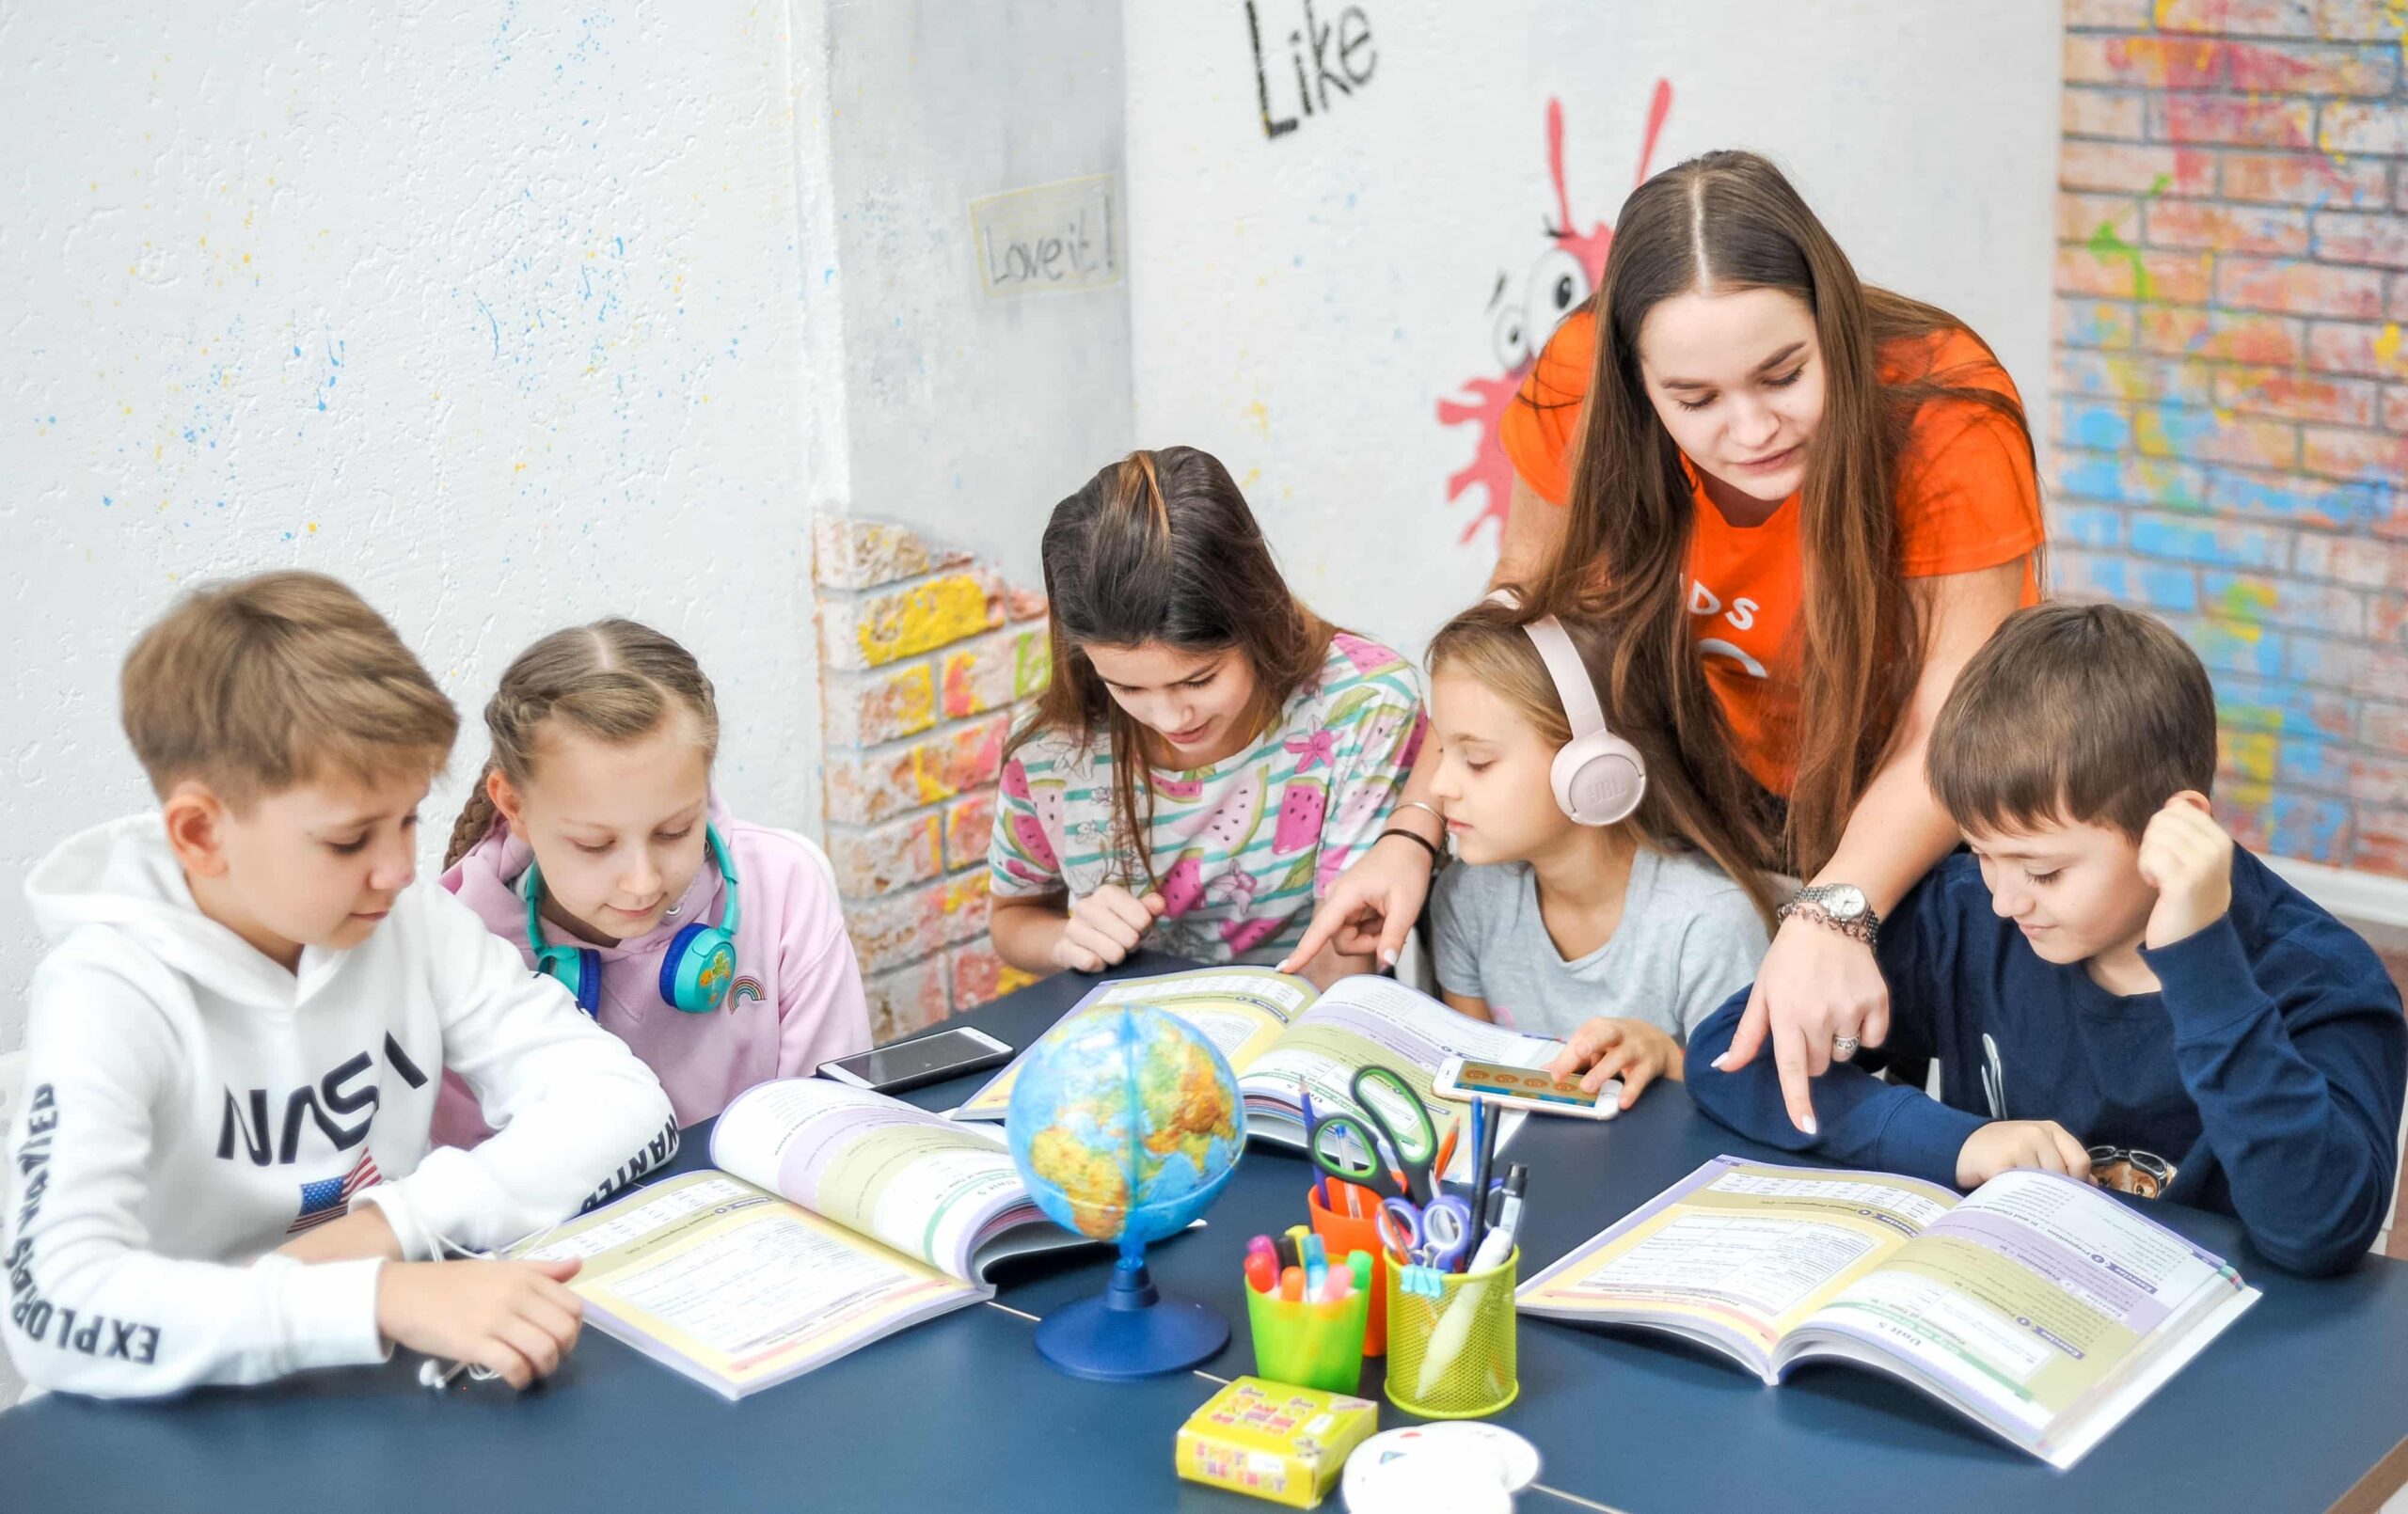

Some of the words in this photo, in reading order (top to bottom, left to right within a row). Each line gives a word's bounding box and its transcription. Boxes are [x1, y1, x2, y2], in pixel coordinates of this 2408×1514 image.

[1246, 0, 1377, 139] Like
[1679, 572, 1761, 631] DS
[2047, 1228, 2090, 1255] Preposition
[2016, 1253, 2060, 1280] Preposition
[2112, 1267, 2151, 1291] Exercise
[2084, 1293, 2122, 1317] Exercise
[1889, 1326, 1921, 1346] Unit
[2040, 1330, 2080, 1355] Exercise
